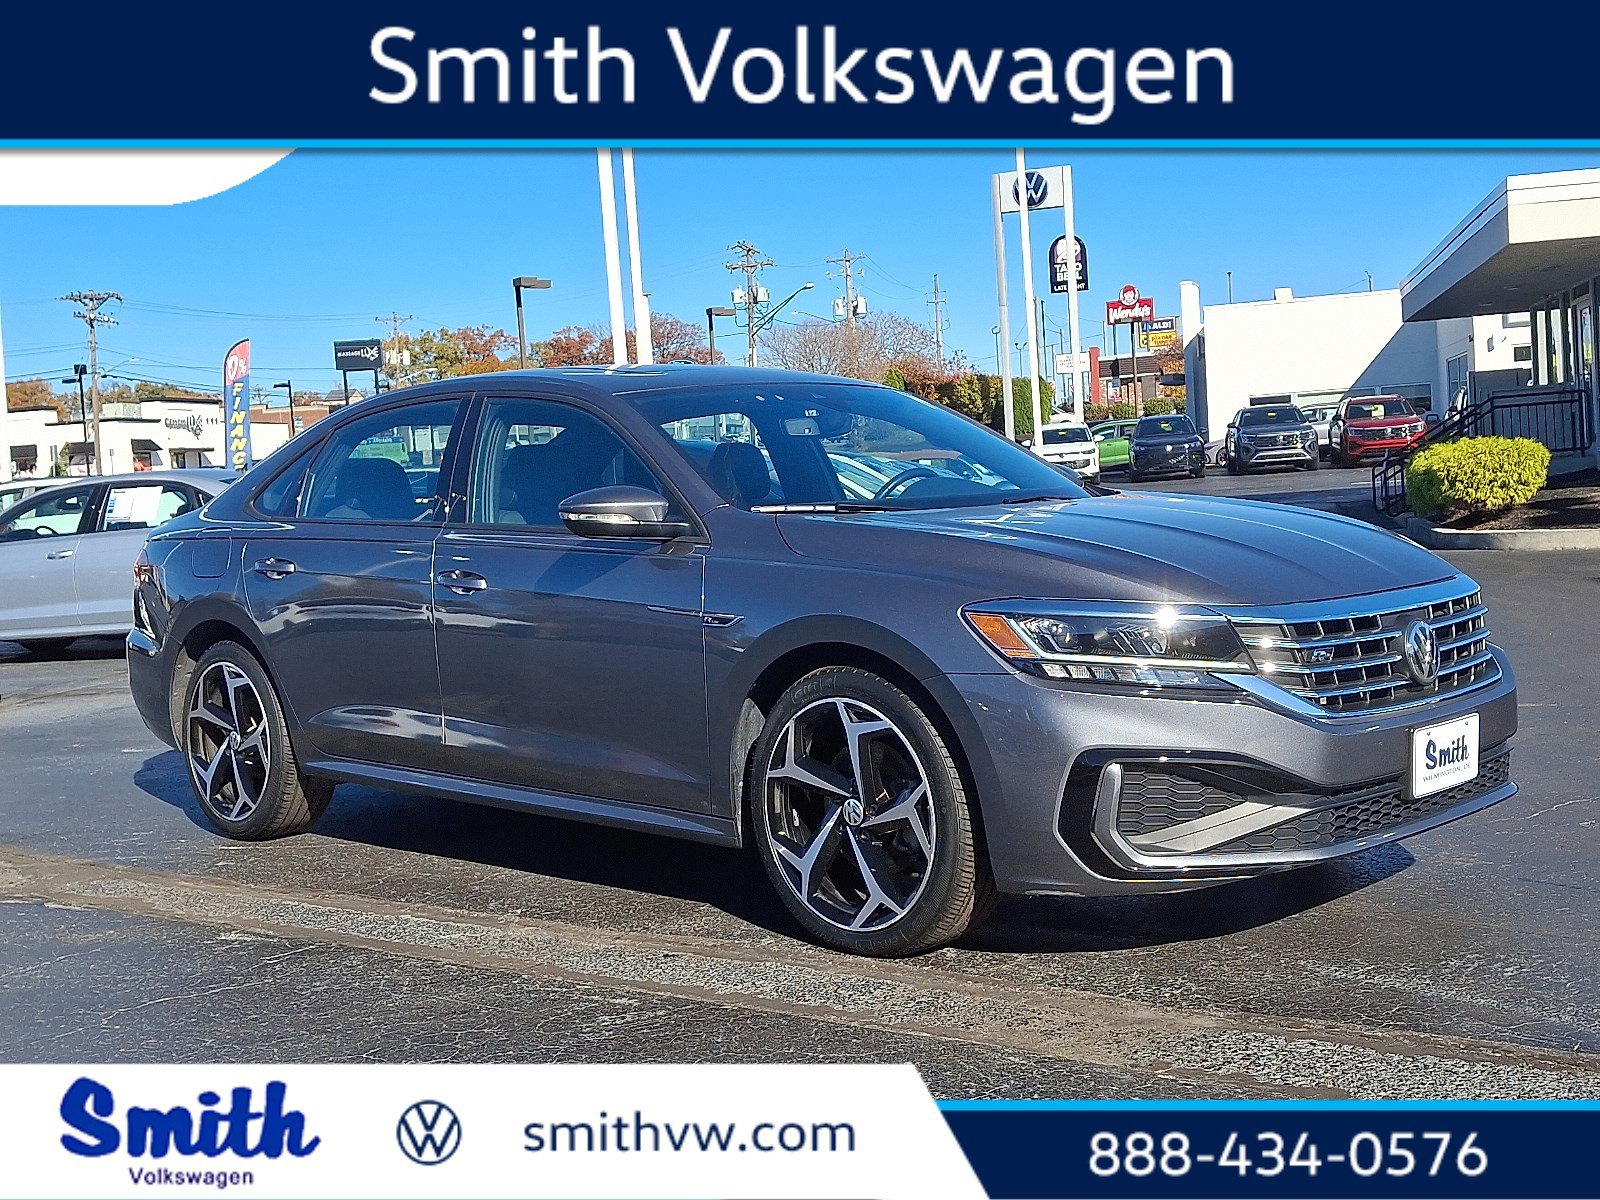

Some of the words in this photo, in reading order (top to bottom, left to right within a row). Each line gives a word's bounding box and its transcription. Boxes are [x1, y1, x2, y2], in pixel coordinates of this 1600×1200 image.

[1054, 262, 1083, 273] TAO
[1109, 303, 1152, 323] Wendy's
[227, 354, 247, 381] 0%
[1425, 735, 1470, 770] Smith
